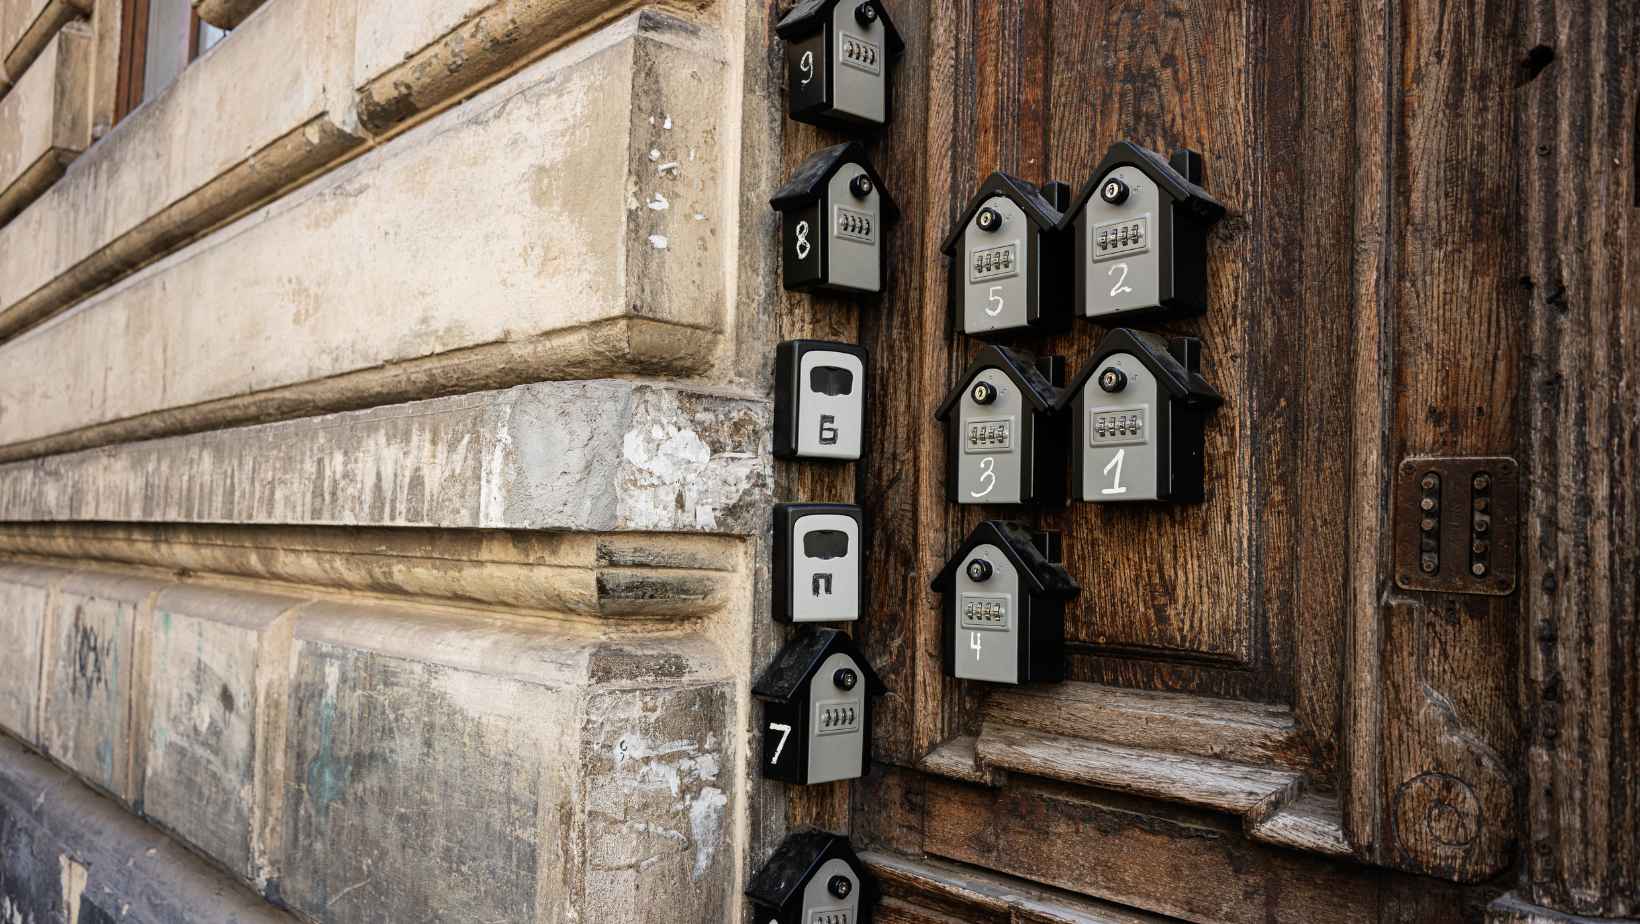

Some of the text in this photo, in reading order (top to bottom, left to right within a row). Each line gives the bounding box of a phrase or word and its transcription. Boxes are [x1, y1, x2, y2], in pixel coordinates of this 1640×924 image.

[800, 51, 814, 84] 9
[796, 220, 811, 260] 8
[1108, 263, 1132, 296] 2
[984, 286, 1004, 317] 5
[819, 414, 839, 445] 6
[970, 457, 996, 498] 3
[1101, 448, 1127, 494] 1
[970, 631, 982, 661] 4
[769, 722, 792, 765] 7
